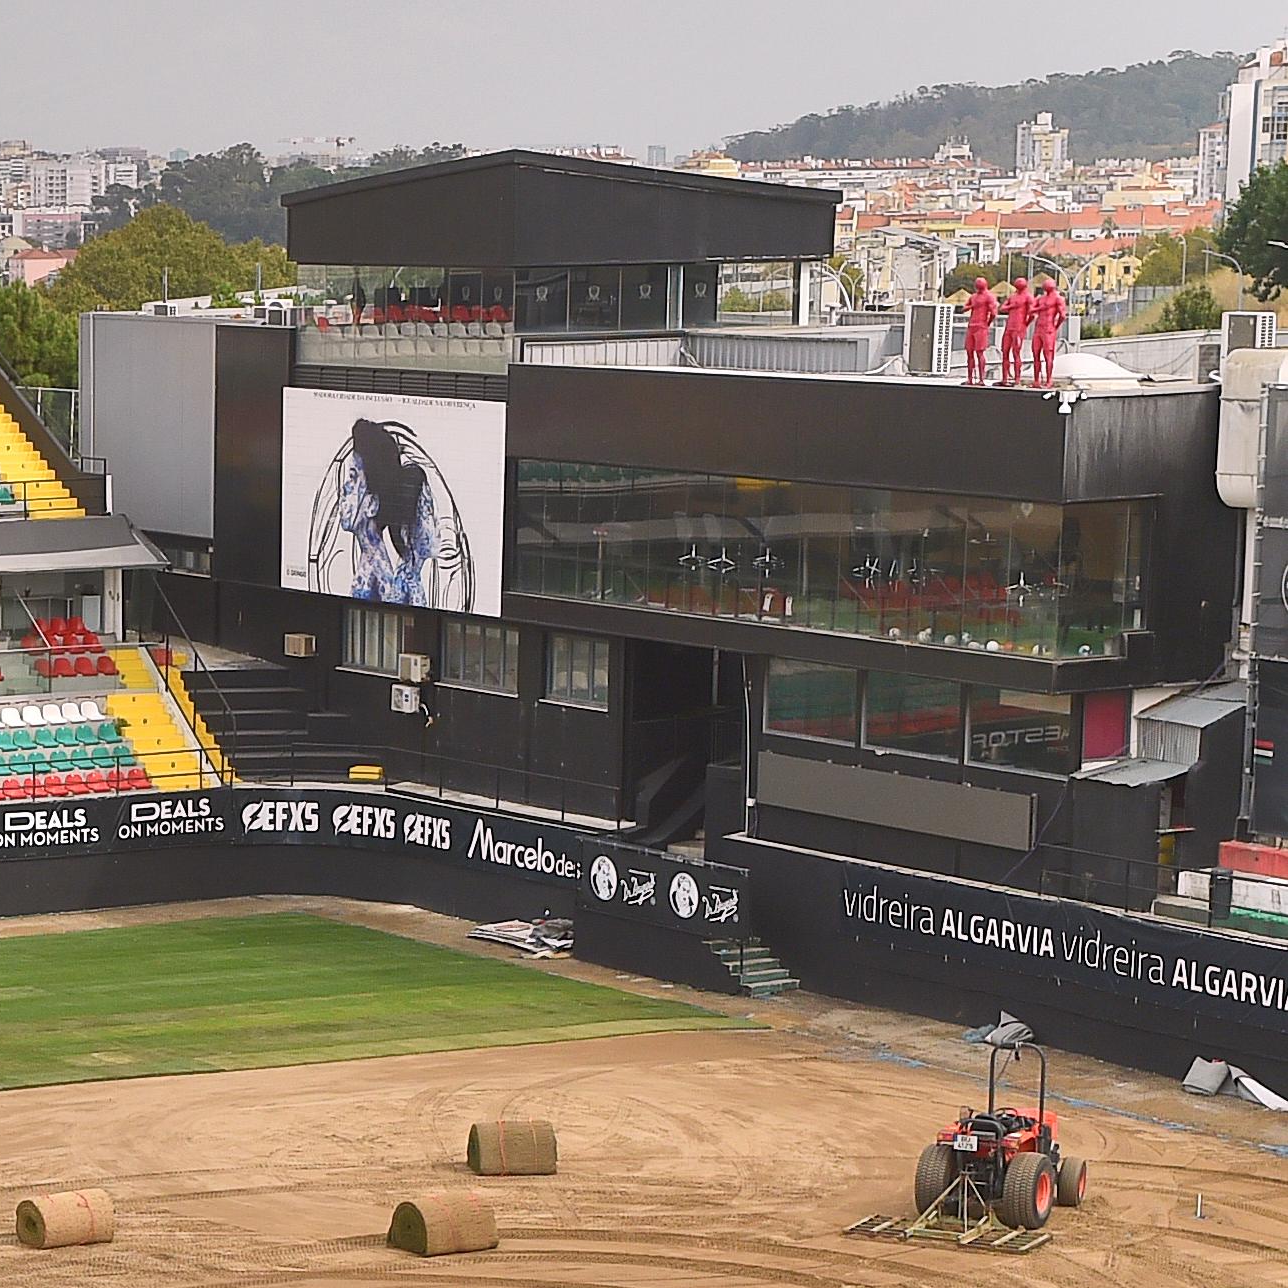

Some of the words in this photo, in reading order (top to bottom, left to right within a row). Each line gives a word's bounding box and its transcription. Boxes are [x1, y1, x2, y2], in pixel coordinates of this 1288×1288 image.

[4, 808, 87, 832] DEALS
[131, 798, 211, 822] DEALS
[20, 827, 100, 847] MOMENTS
[118, 823, 142, 840] ON
[146, 817, 225, 837] MOMENTS
[843, 884, 935, 936] vidreira
[941, 908, 1056, 958] ALGARVIA
[1061, 926, 1167, 986] vidreira
[1171, 958, 1288, 1011] ALGARVI
